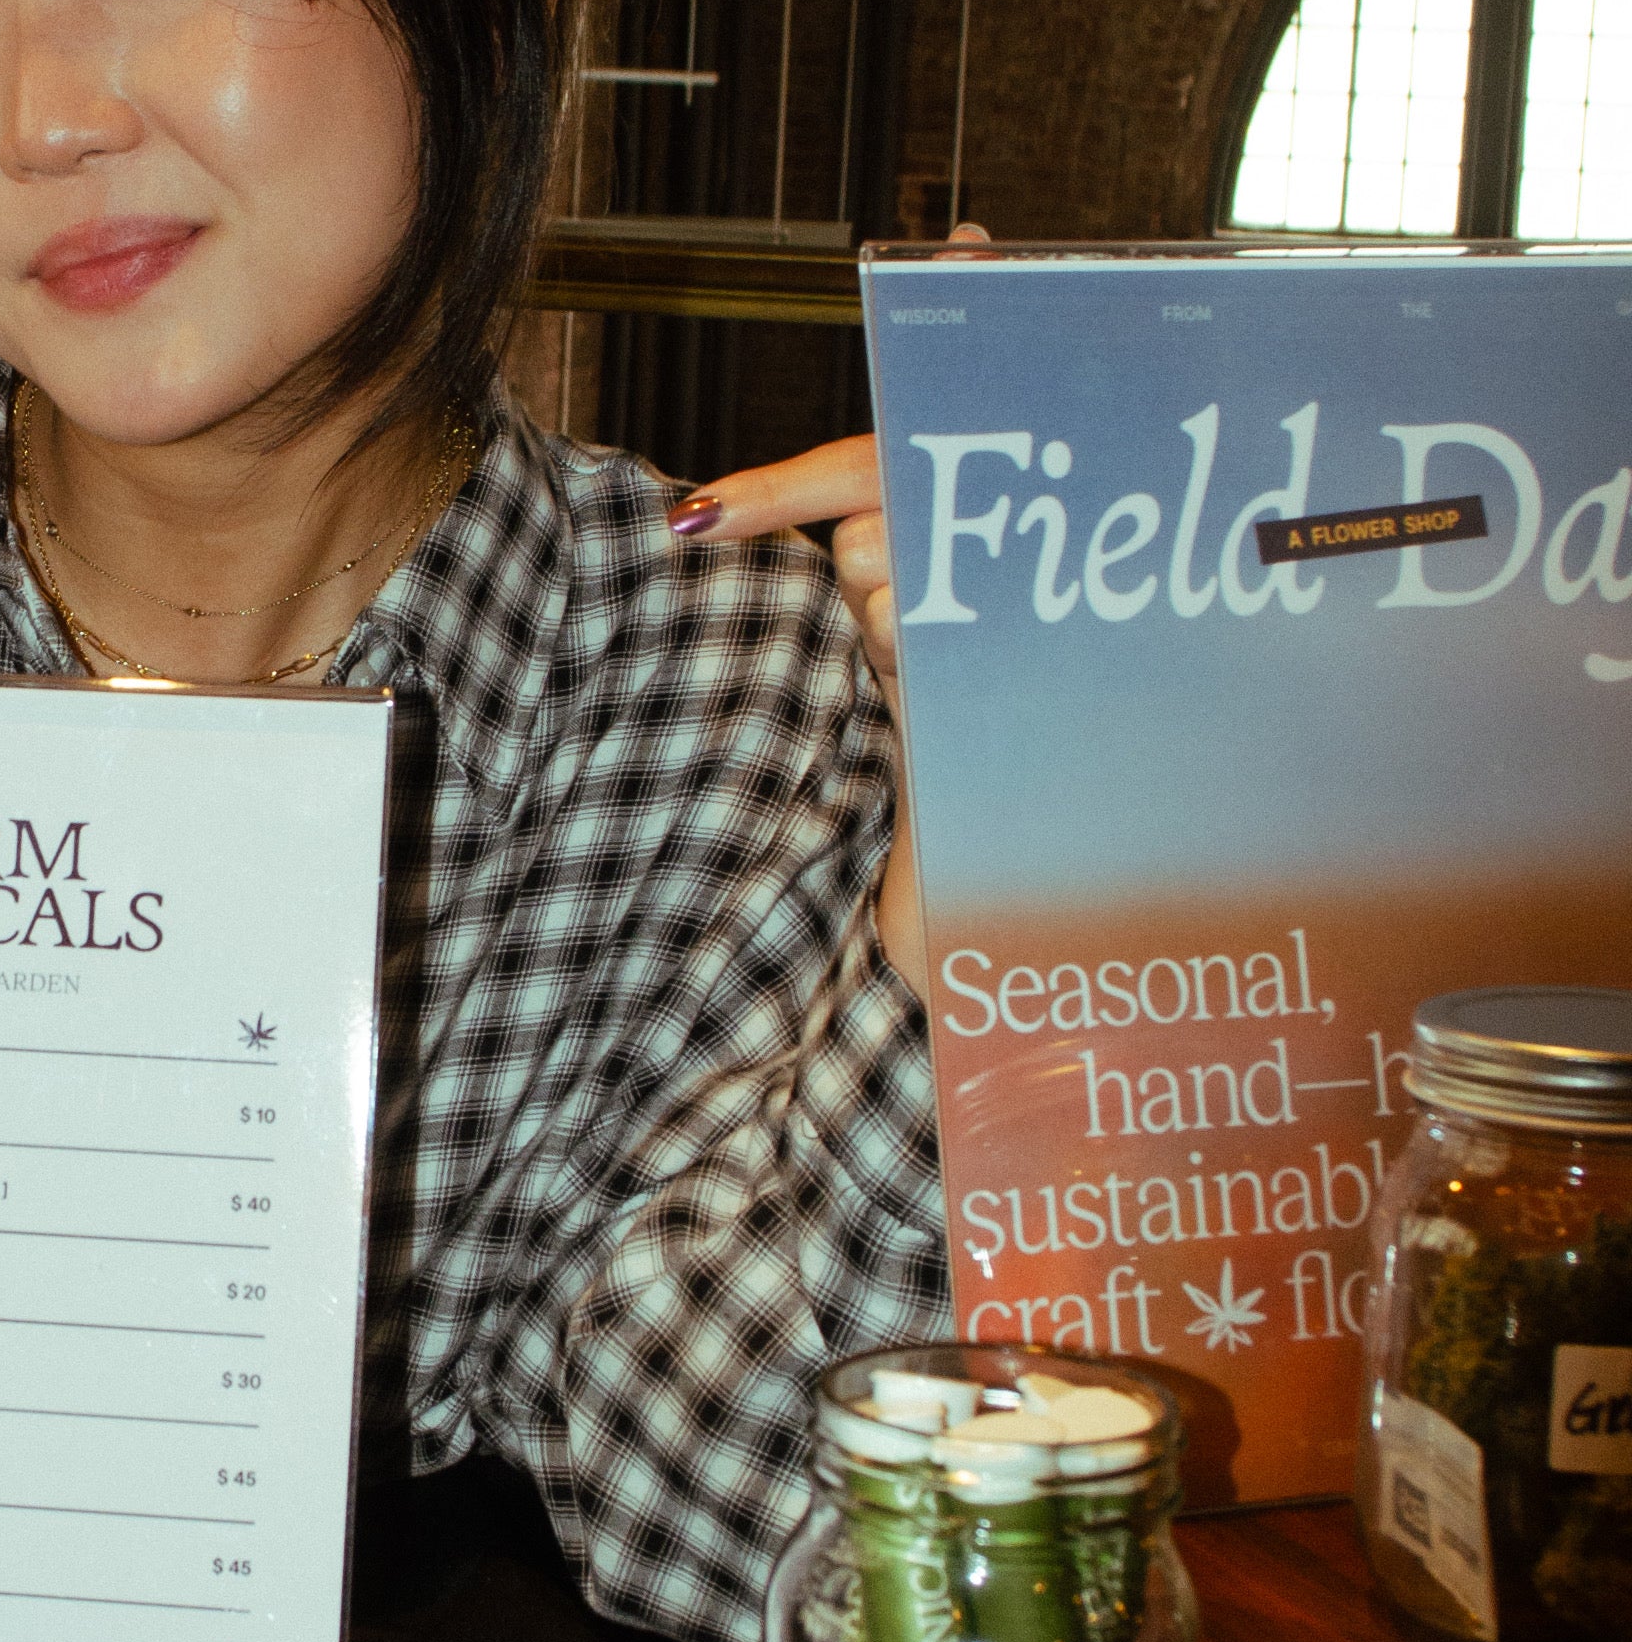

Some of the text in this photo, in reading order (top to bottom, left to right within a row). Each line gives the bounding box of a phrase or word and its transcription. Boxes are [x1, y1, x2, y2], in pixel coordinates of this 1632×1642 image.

[888, 301, 1434, 325] WISDOM FROM THE
[900, 400, 1632, 682] Field Da
[1287, 508, 1462, 550] A FLOWER SHOP
[940, 927, 1336, 1037] Seasonal,
[966, 1264, 1165, 1355] craft
